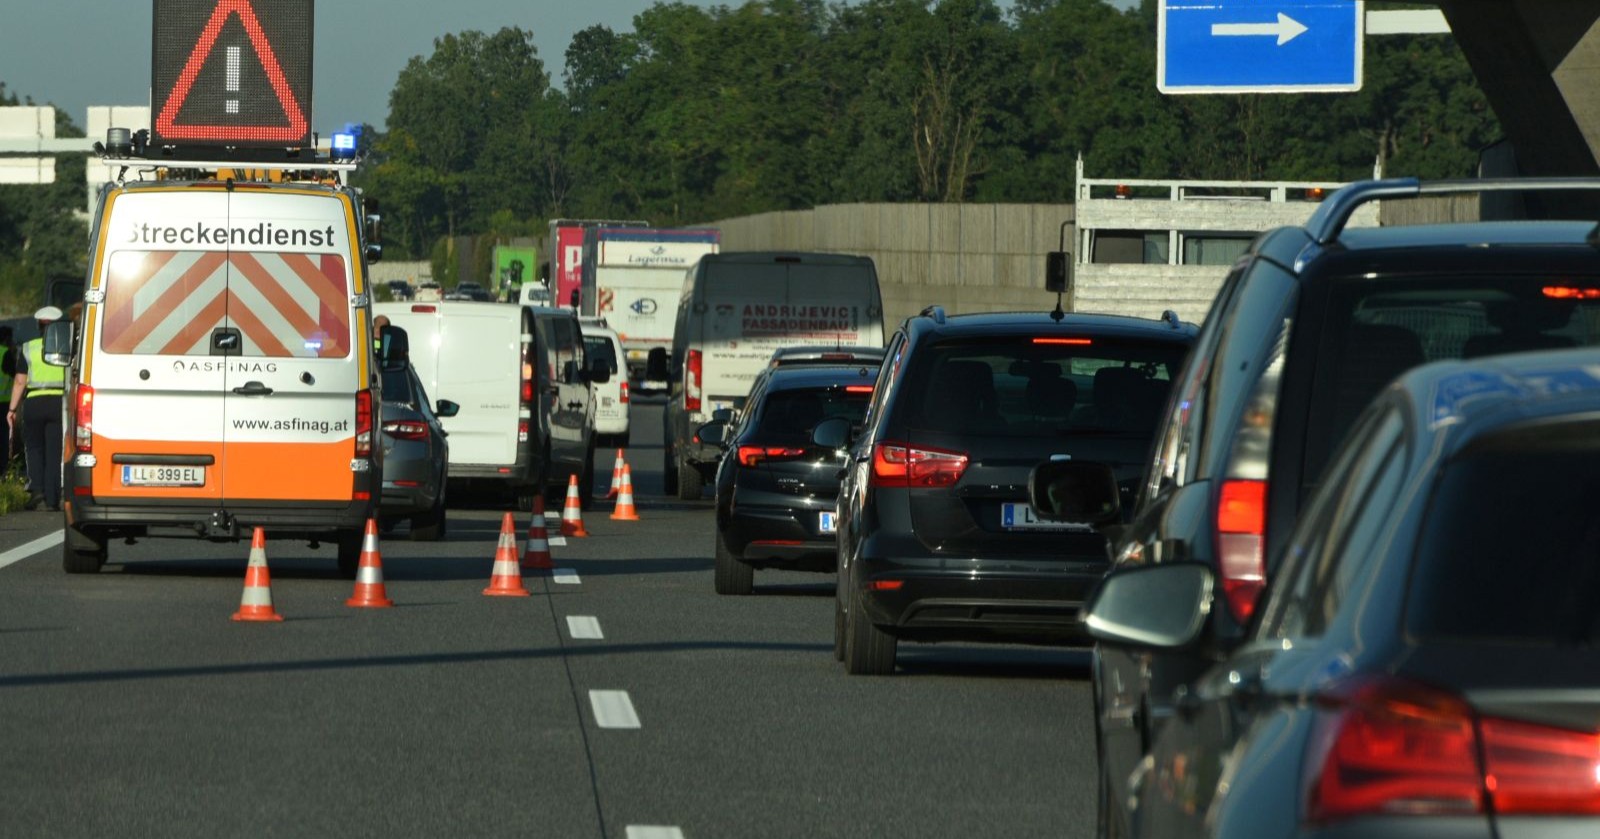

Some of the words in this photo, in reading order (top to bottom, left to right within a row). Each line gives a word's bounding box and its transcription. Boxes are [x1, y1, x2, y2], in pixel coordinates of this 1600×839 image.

[743, 304, 849, 317] ANDRIJEVIC
[742, 318, 849, 331] FASSADENBAU
[233, 418, 348, 434] www.asfinag.at
[134, 468, 147, 480] LL
[157, 468, 180, 481] 399
[184, 469, 198, 481] EL
